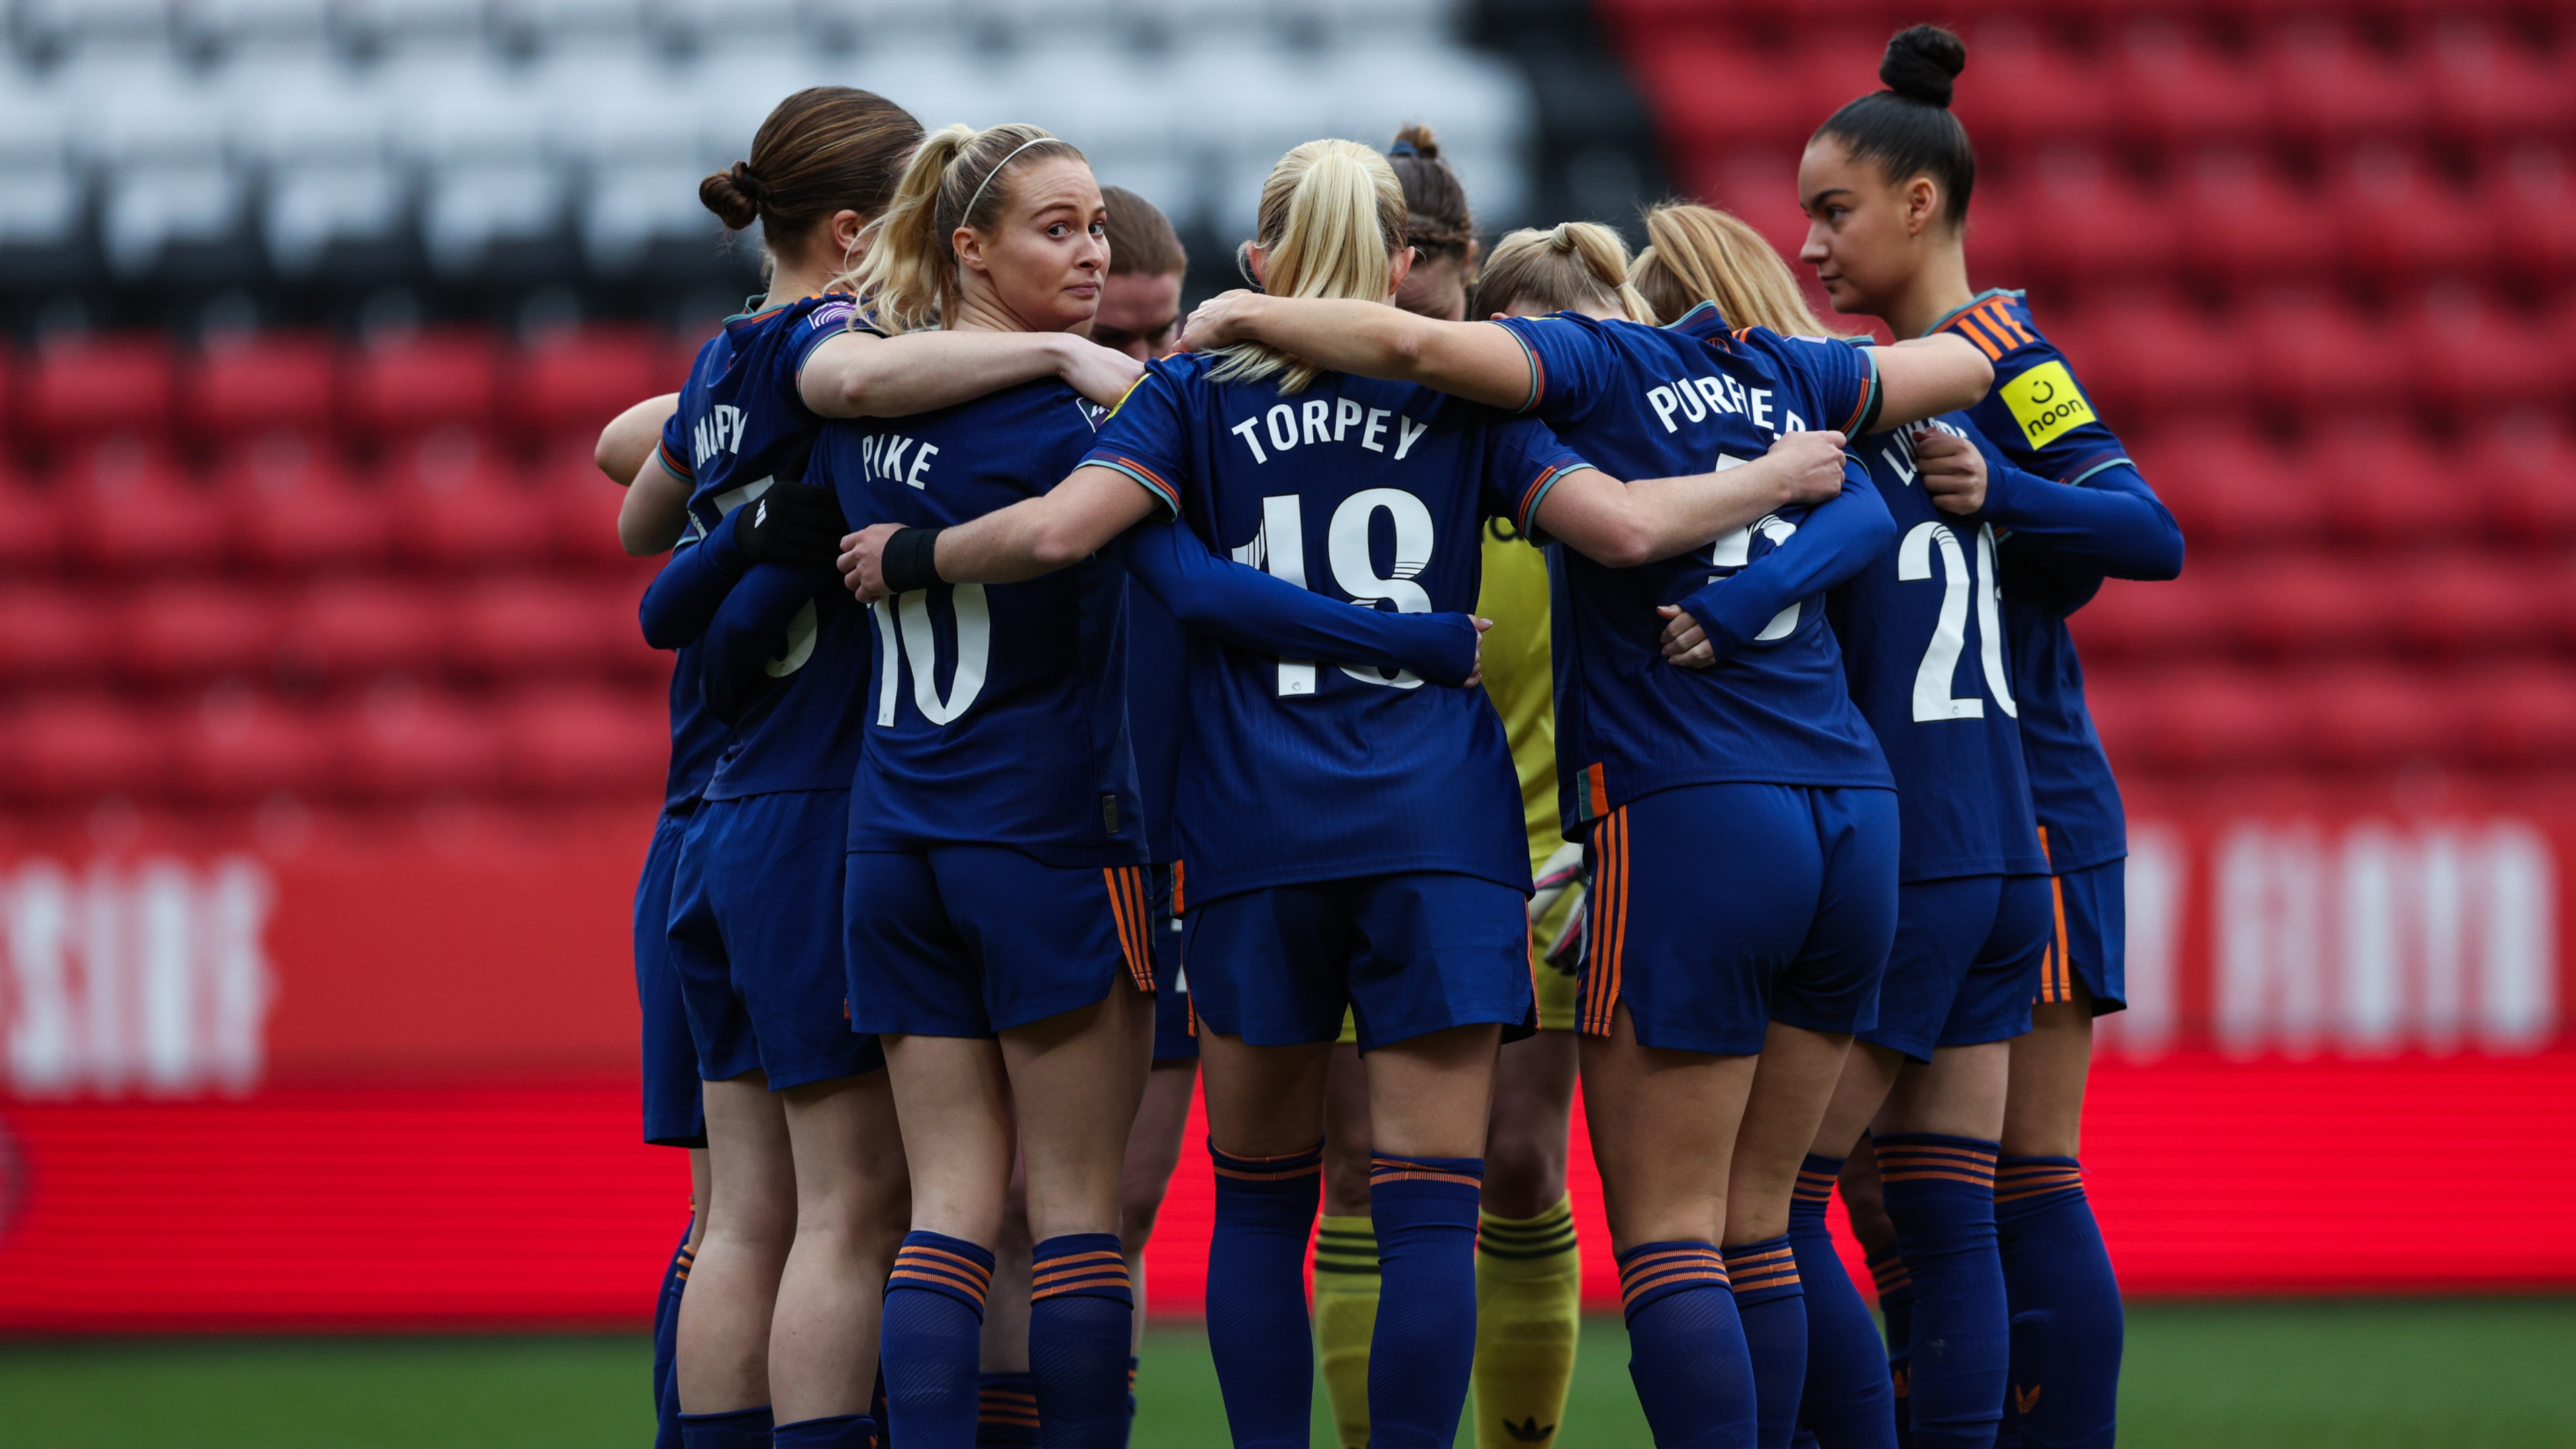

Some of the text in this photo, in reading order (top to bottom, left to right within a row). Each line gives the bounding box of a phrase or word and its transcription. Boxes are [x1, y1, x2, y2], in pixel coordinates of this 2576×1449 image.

[1231, 397, 1428, 464] TORPEY
[1646, 373, 1806, 440] PURFIED
[2027, 399, 2084, 436] noon
[862, 434, 939, 490] PIKE
[1231, 487, 1435, 699] 18
[866, 583, 990, 727] 10
